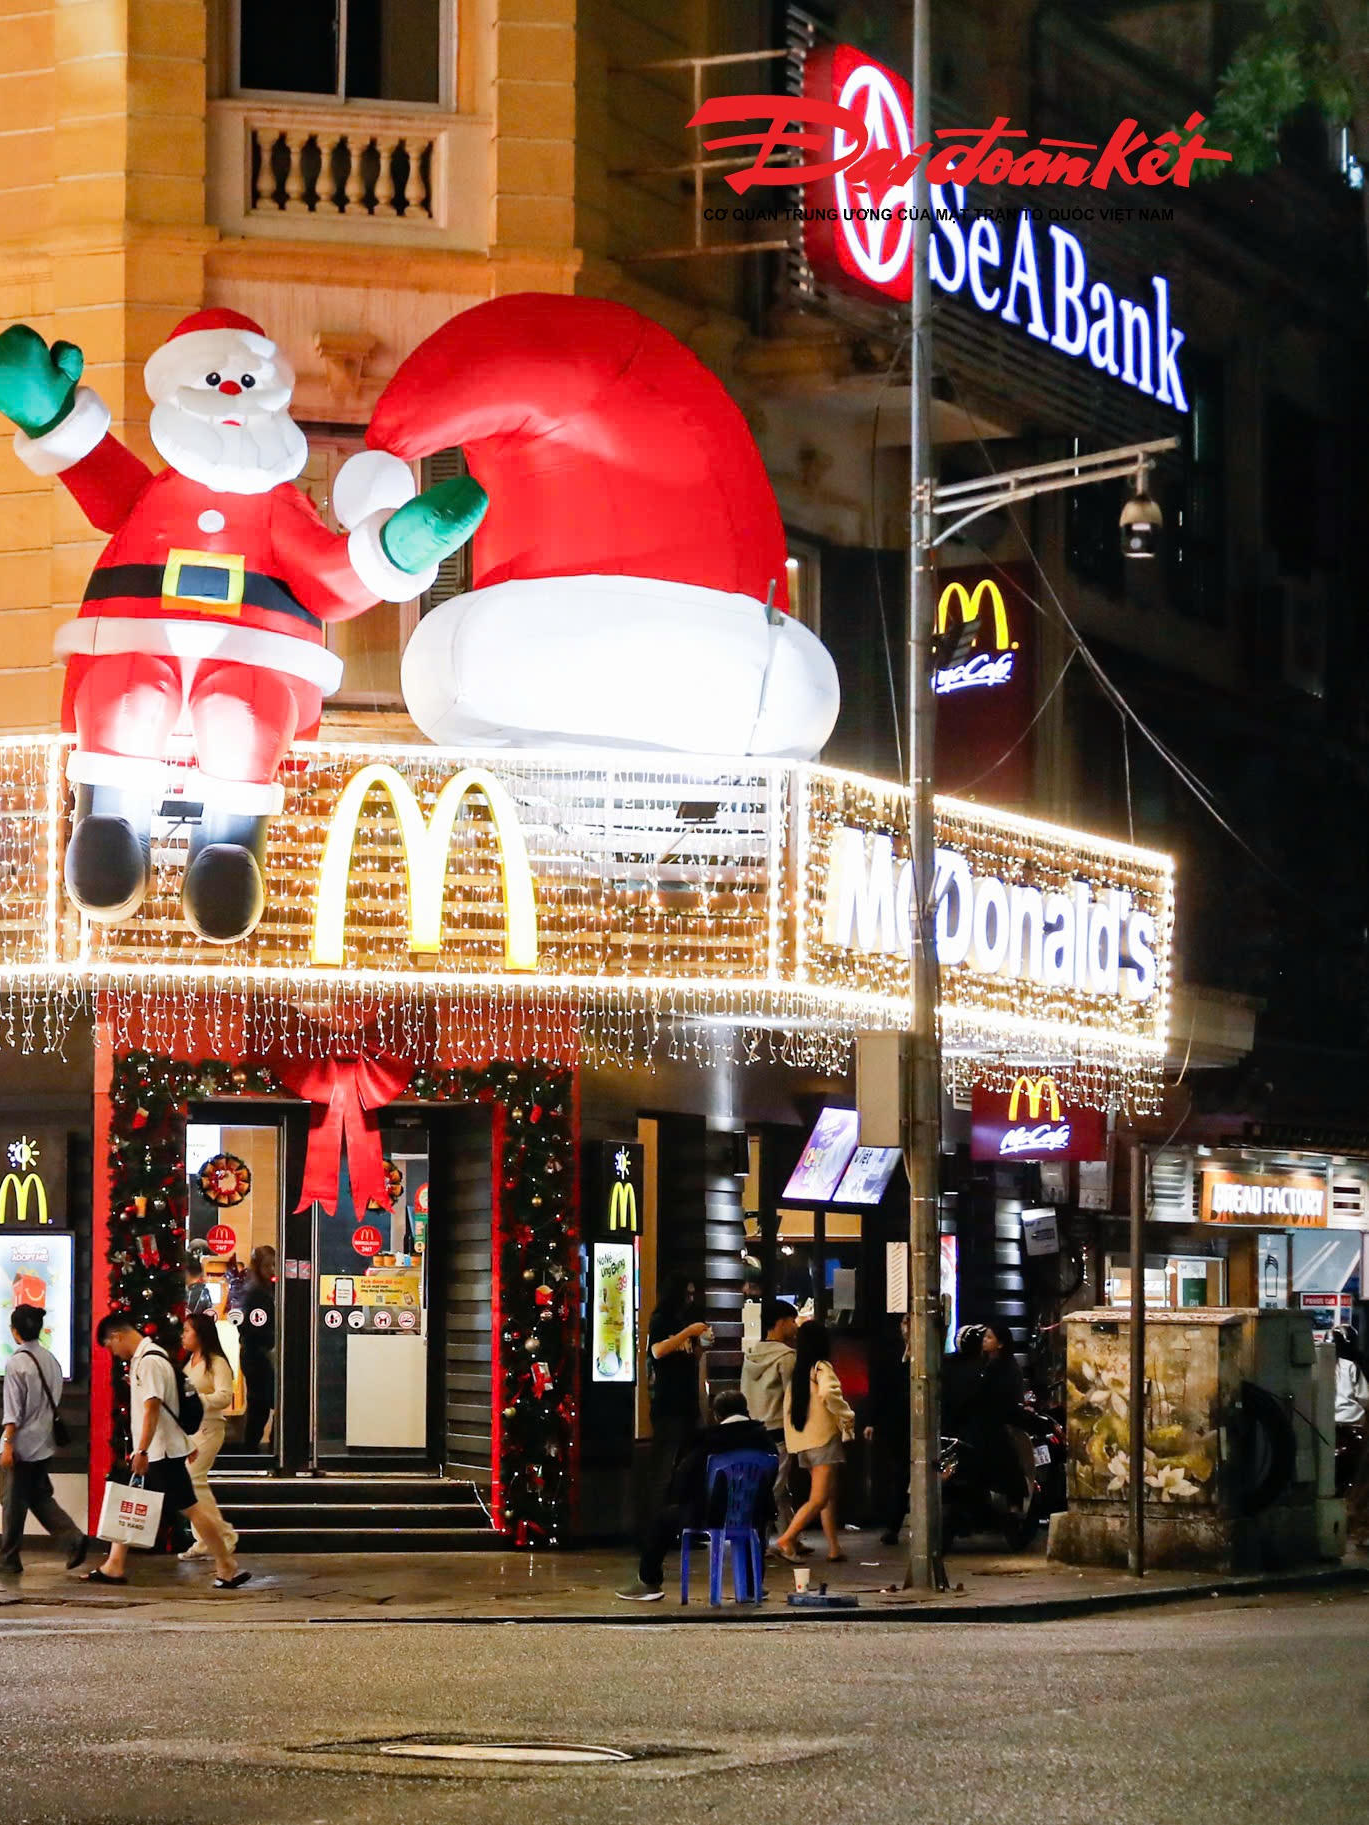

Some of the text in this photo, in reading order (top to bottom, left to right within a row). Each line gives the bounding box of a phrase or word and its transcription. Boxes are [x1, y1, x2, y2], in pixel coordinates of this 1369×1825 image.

[929, 168, 1189, 413] SeABank
[1213, 1184, 1325, 1217] BREAD FACTORY
